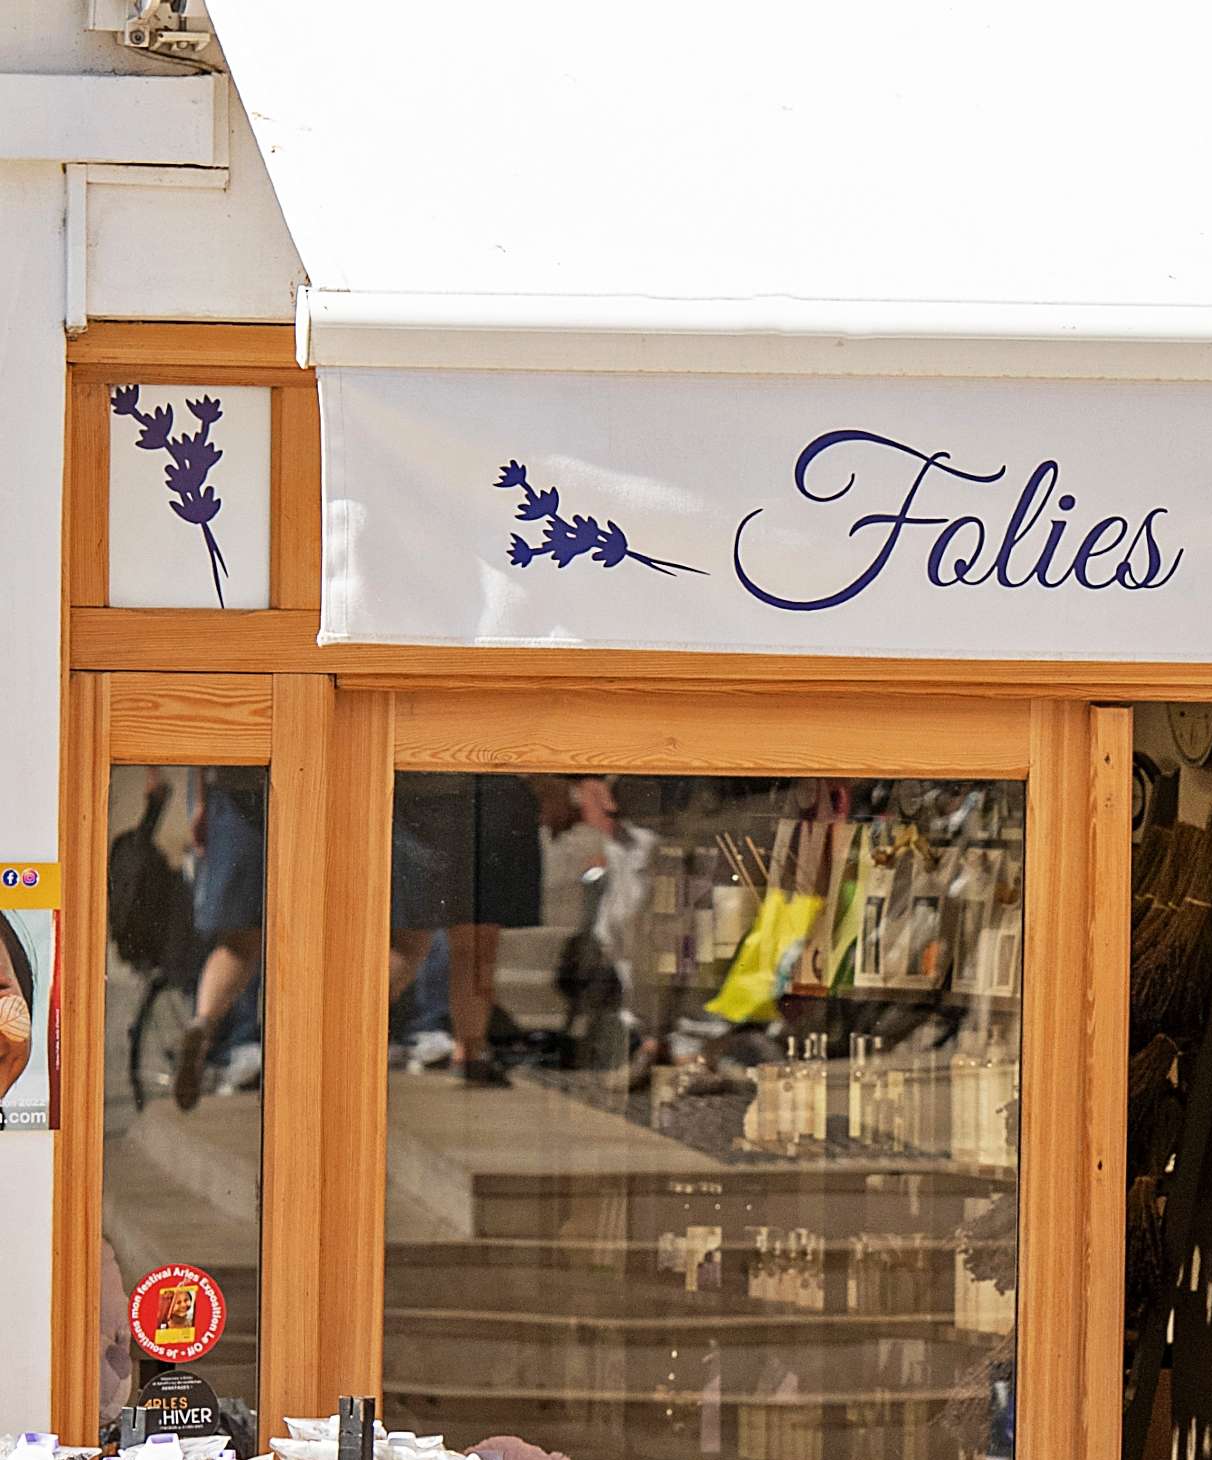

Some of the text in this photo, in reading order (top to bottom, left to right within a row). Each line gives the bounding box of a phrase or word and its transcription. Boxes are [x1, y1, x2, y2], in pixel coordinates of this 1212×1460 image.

[734, 429, 1184, 611] Folies
[136, 1267, 172, 1295] festival
[131, 1295, 142, 1319] mon
[199, 1277, 222, 1332] Exposition
[132, 1320, 166, 1356] soutiens
[143, 1396, 188, 1410] ARLES
[162, 1407, 213, 1425] HIVER
